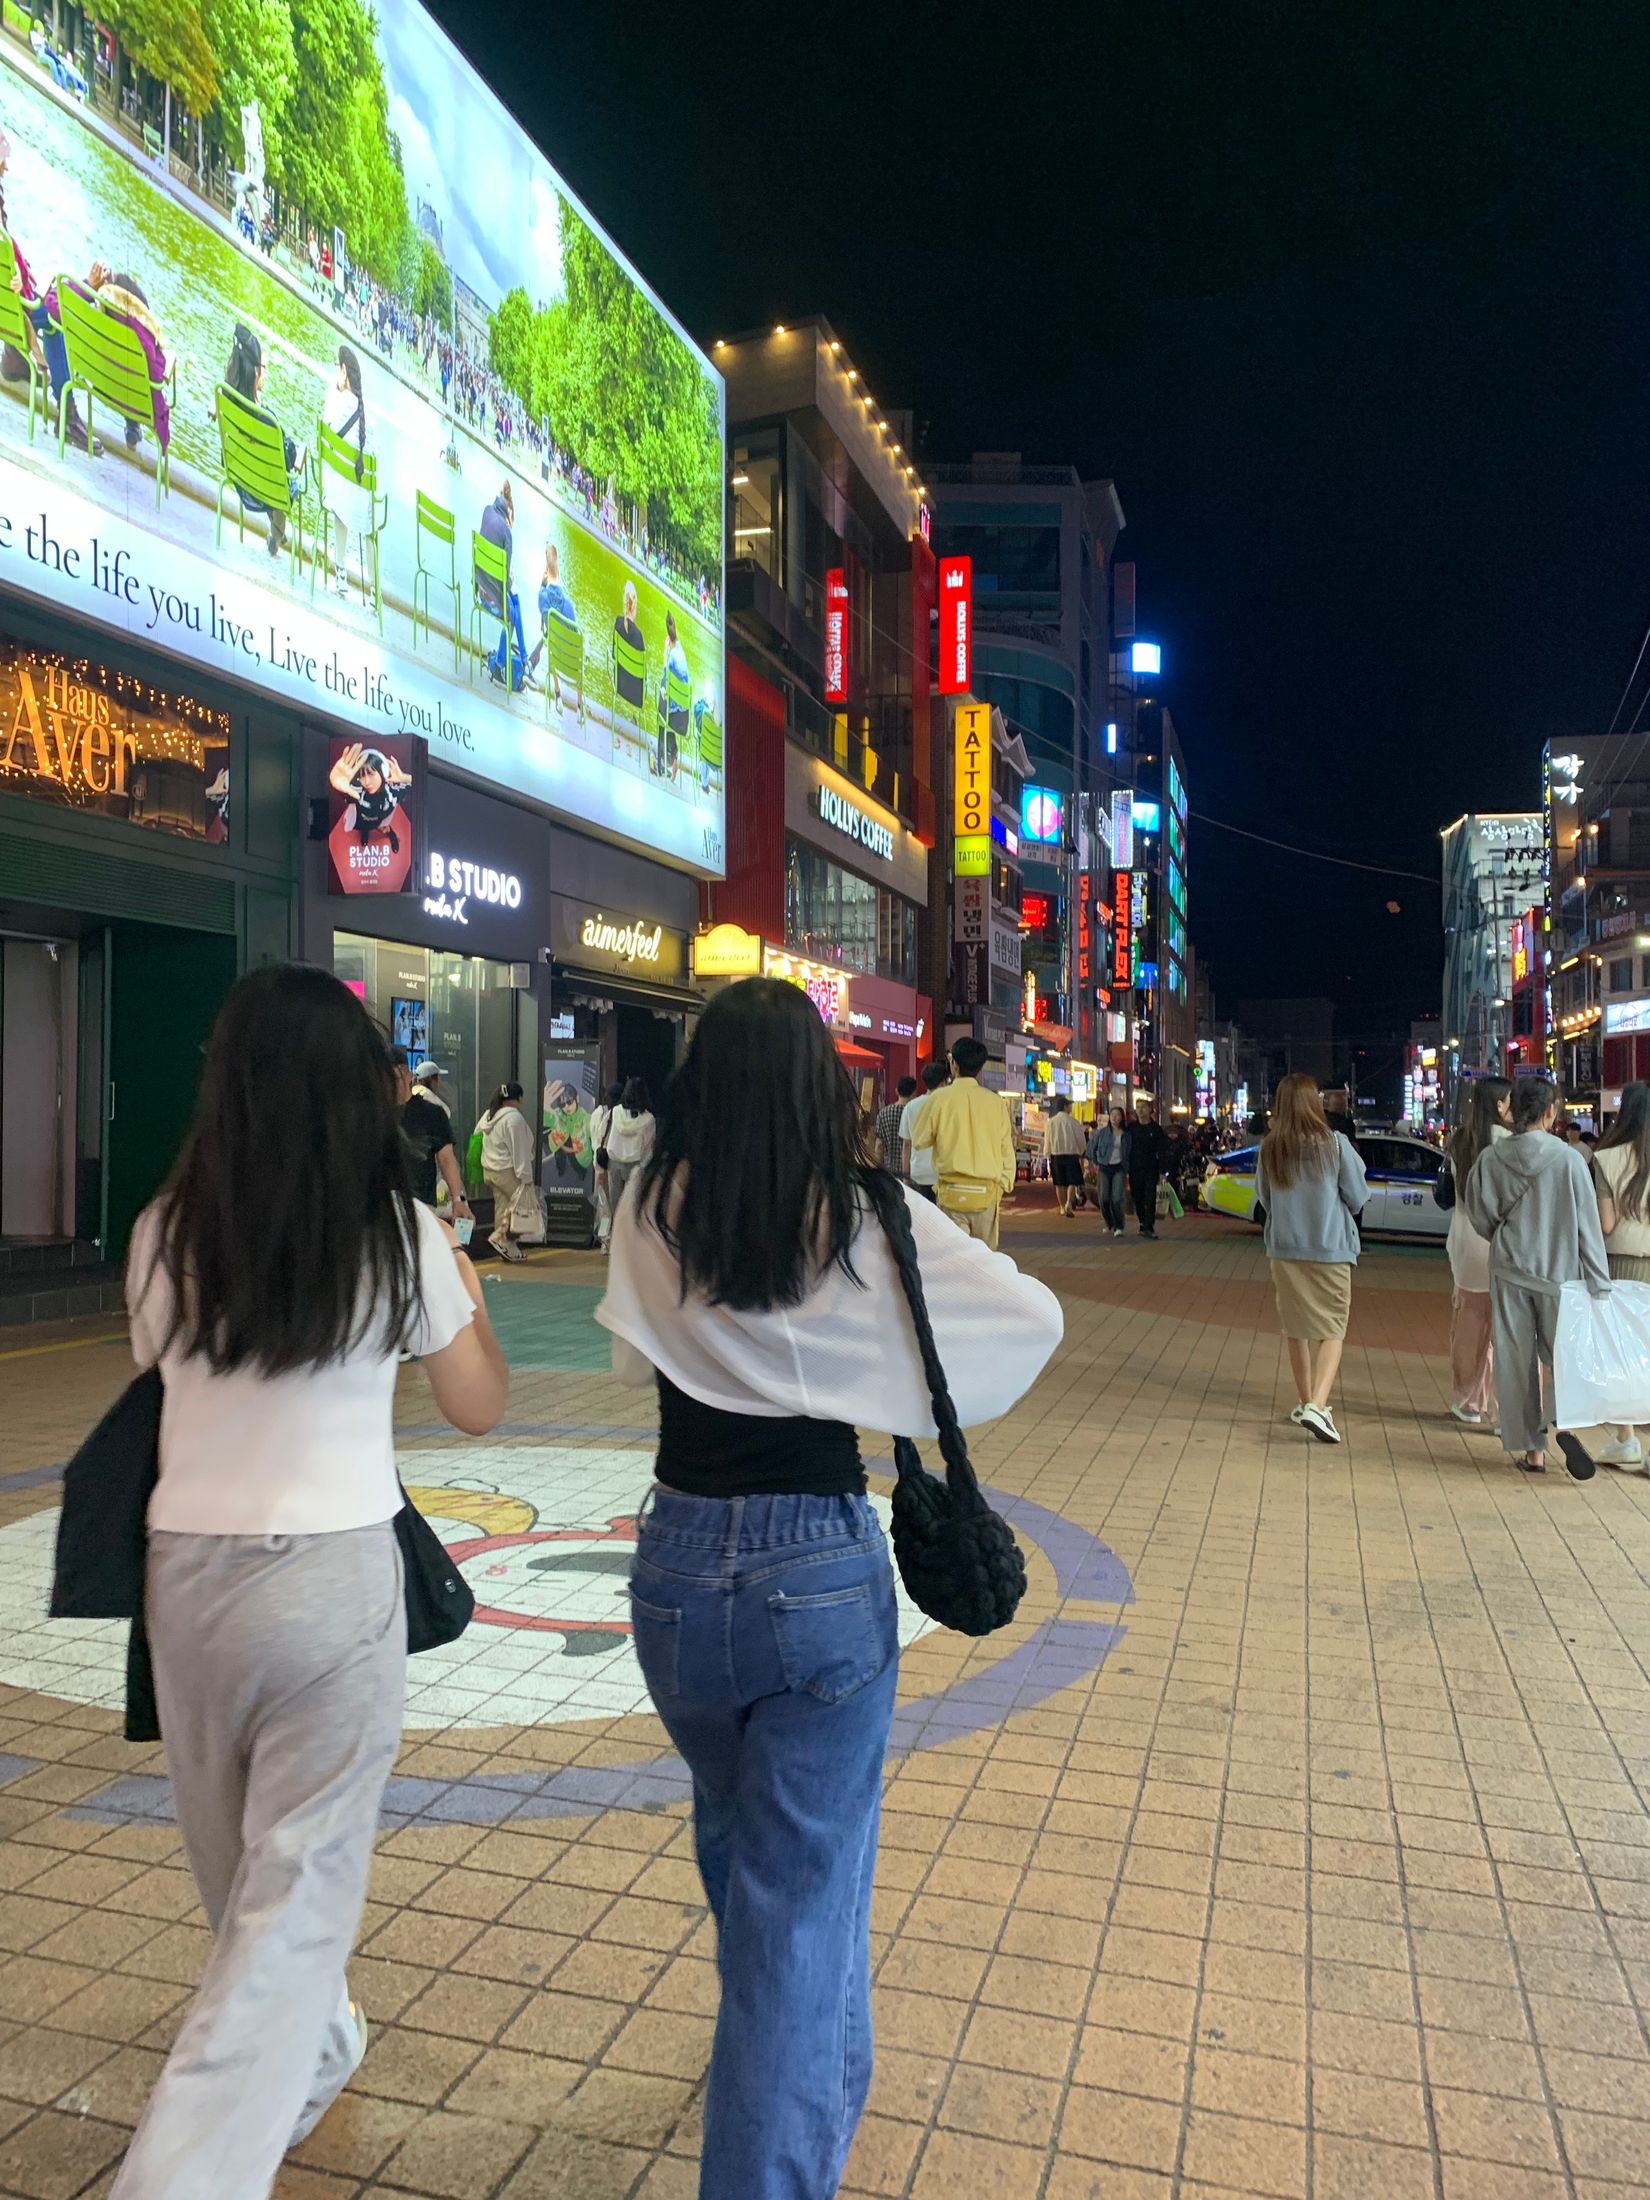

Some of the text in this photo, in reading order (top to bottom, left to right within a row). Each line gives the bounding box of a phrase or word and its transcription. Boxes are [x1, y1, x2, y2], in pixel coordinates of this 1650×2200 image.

[25, 514, 80, 579] the
[90, 538, 140, 605] life
[146, 584, 203, 629] you
[209, 594, 261, 667] live,
[269, 626, 316, 682] Live
[325, 652, 357, 700] the
[364, 667, 393, 716] life
[397, 699, 433, 735] you
[438, 701, 475, 752] love.
[956, 600, 967, 684] HOLLYS COFFEE
[46, 665, 109, 725] Haus
[0, 670, 136, 798] Aver
[963, 709, 981, 829] TATTOO
[349, 844, 390, 857] PLAN.B
[820, 784, 894, 862] HOLLYS COFFEE
[349, 856, 390, 868] STUDIO
[448, 857, 522, 909] STUDIO
[958, 849, 986, 863] TATTOO
[582, 914, 662, 963] aimerfeel
[550, 1186, 584, 1195] ELEVATOR
